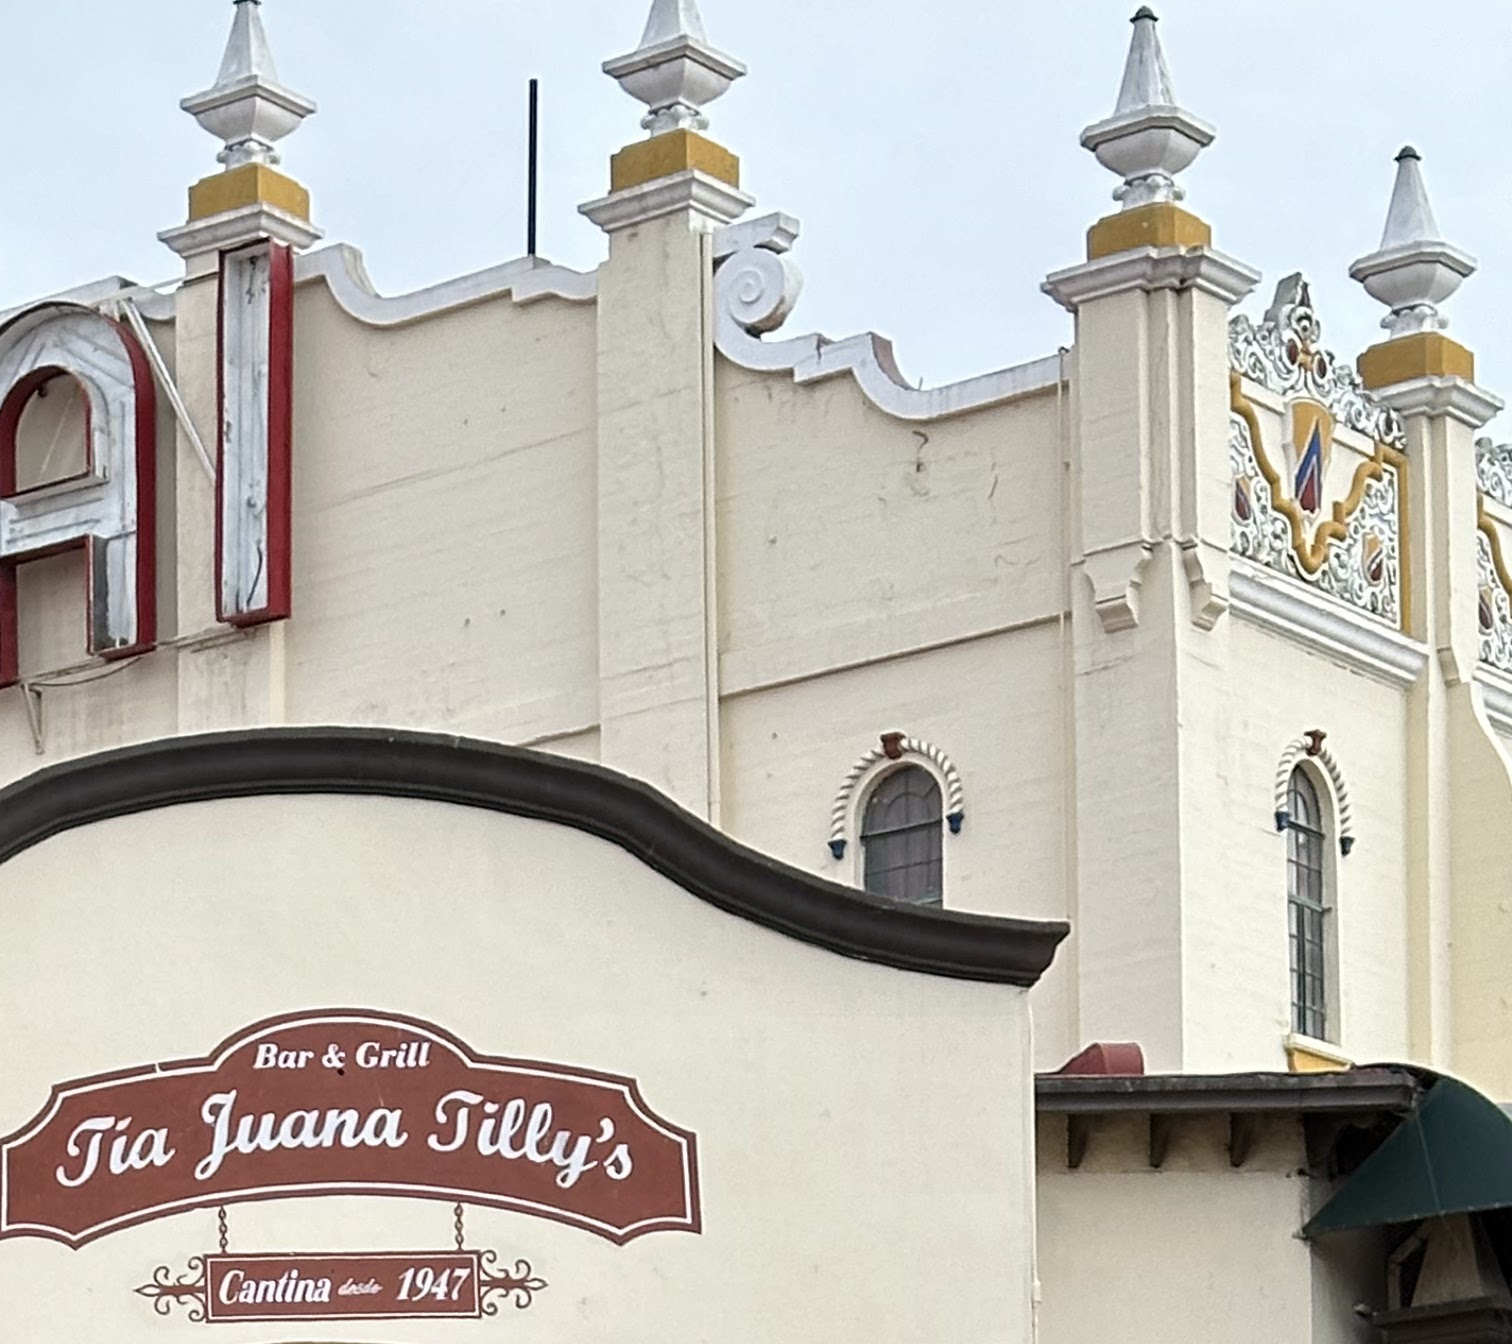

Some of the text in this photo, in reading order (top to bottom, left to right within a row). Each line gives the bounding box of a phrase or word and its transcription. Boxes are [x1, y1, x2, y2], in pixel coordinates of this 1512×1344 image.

[254, 1041, 431, 1069] Bar & Grill
[194, 1089, 408, 1180] Juana
[427, 1090, 633, 1188] Tilly's
[219, 1269, 331, 1304] Cantina
[396, 1267, 471, 1301] 1947
